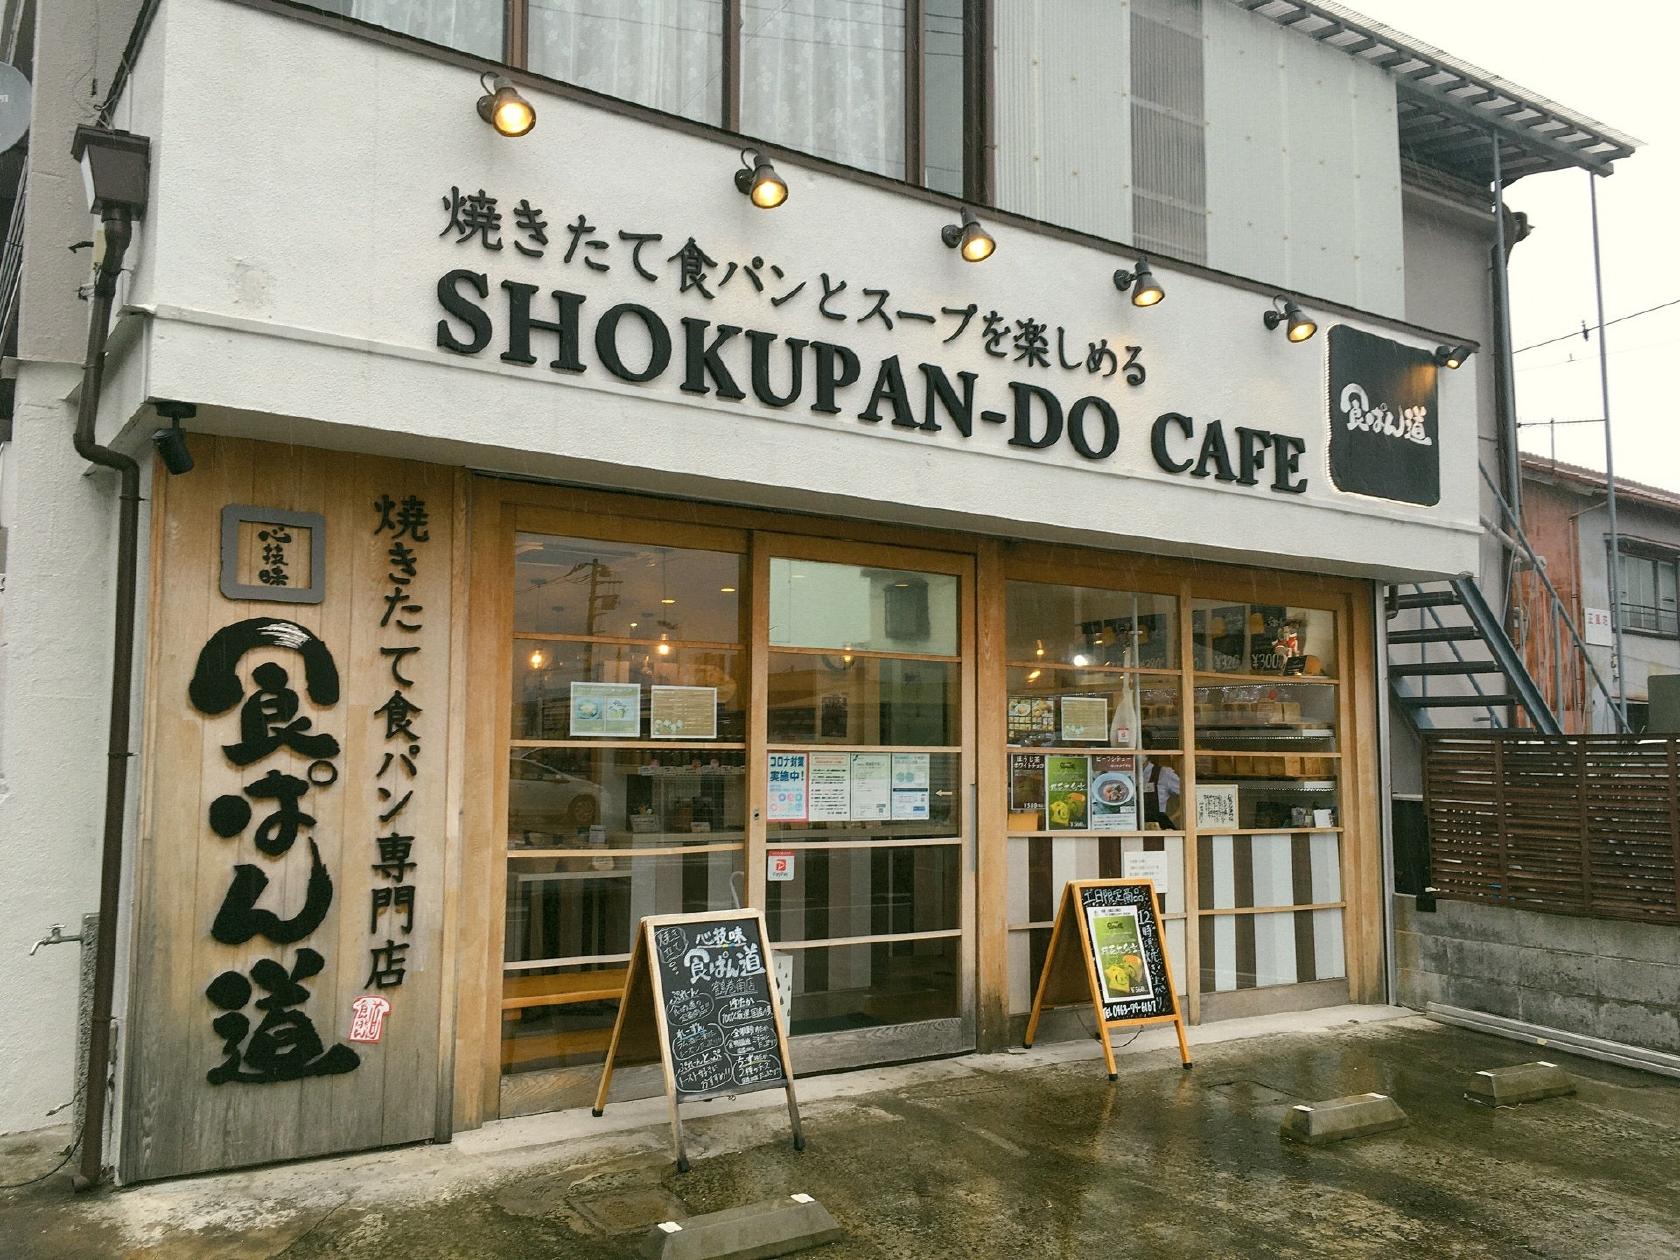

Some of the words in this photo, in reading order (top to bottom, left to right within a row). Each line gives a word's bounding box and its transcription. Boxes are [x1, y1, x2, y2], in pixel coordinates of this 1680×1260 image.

[439, 185, 1146, 386] 焼きたて食パンとスープを楽しめる
[436, 268, 1120, 460] SHOKUPAN-DO
[1151, 411, 1308, 494] CAFE
[1340, 382, 1433, 447] 食ぱん道
[258, 526, 292, 586] 心技味
[364, 494, 430, 990] 焼きたて食パン専門店
[770, 756, 804, 768] コロナ対策
[189, 616, 361, 1085] 食ぱん道
[683, 943, 767, 984] 食ぱん道
[695, 926, 748, 944] 心技味
